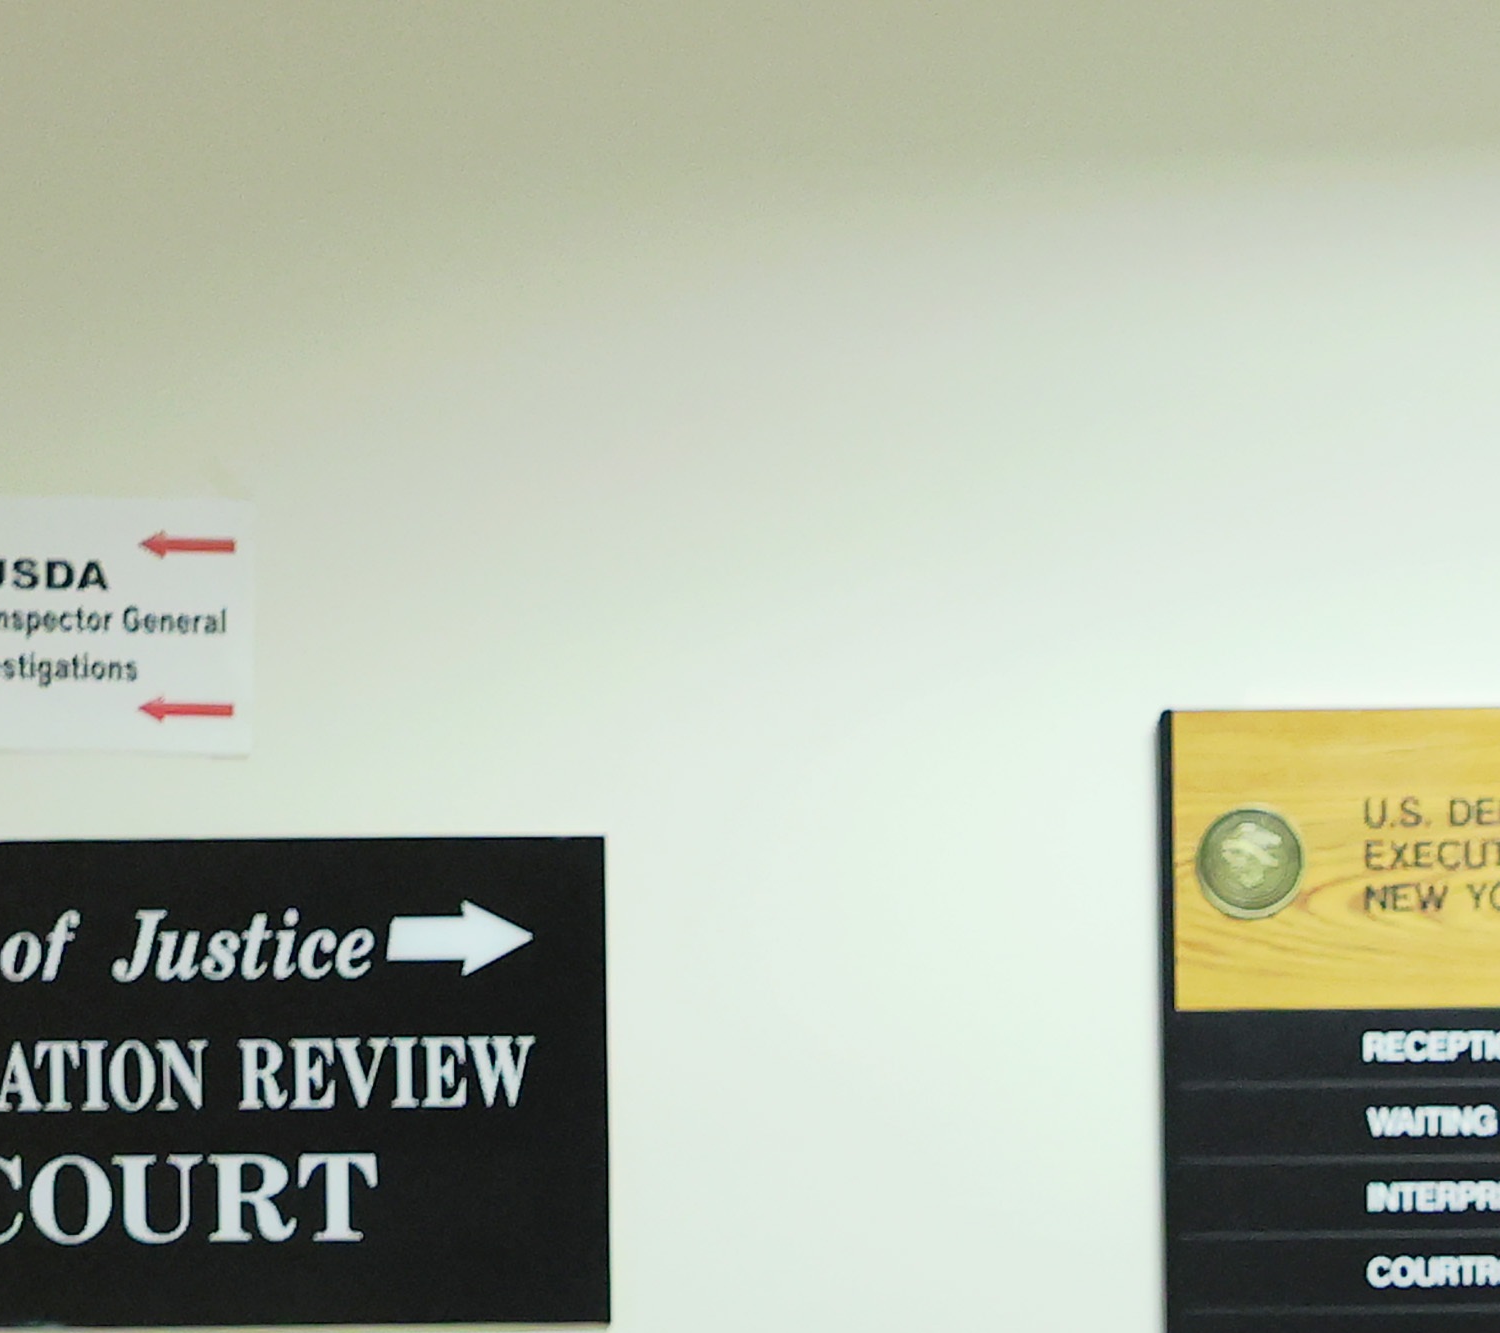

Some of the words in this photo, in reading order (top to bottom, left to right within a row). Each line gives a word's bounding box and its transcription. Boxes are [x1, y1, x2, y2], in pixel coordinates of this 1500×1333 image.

[122, 605, 226, 635] General
[1363, 797, 1431, 830] U.S.
[1363, 883, 1448, 912] NEW
[0, 909, 81, 982] of
[111, 908, 375, 983] Justice
[238, 1035, 536, 1110] REVIEW
[1365, 1104, 1499, 1137] WAITING
